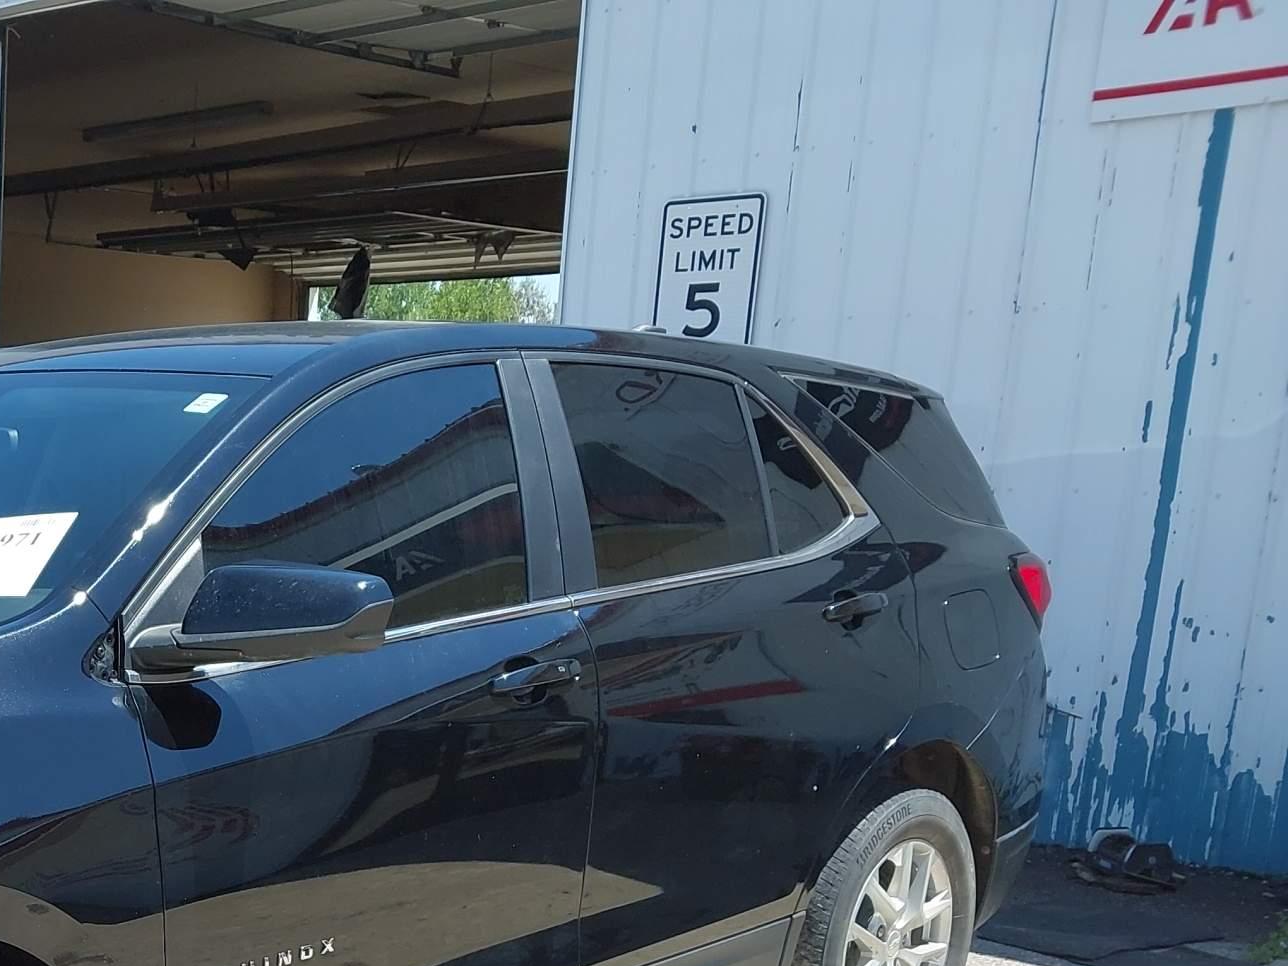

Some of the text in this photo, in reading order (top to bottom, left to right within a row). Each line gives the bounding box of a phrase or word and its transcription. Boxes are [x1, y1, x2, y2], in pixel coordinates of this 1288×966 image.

[669, 212, 754, 239] SPEED
[674, 247, 741, 273] LIMIT
[682, 282, 721, 338] 5
